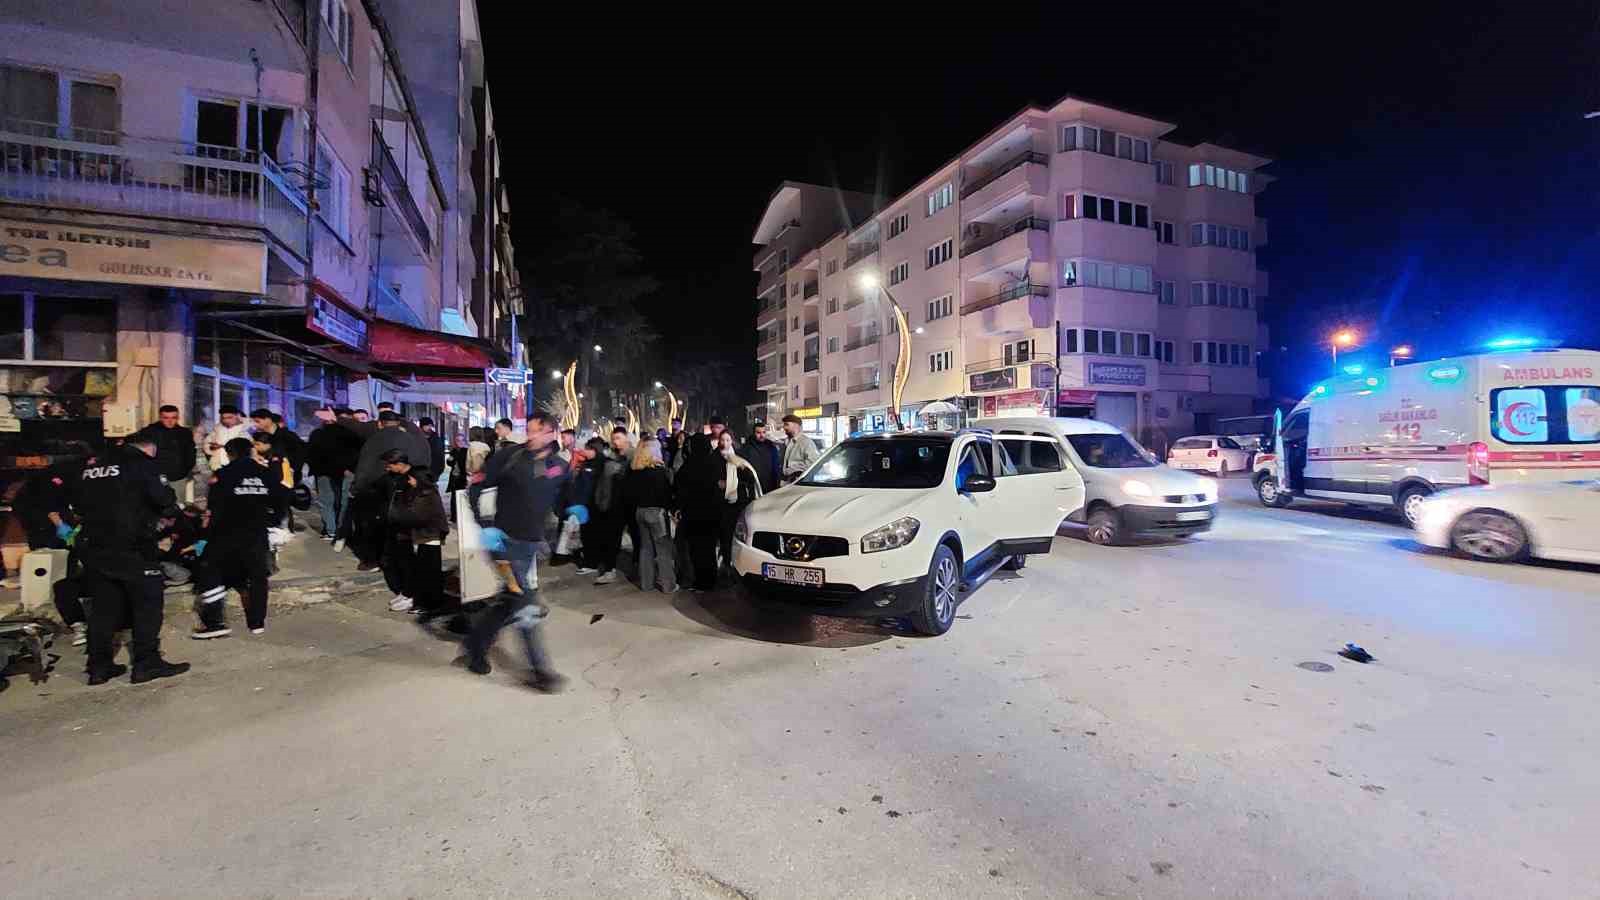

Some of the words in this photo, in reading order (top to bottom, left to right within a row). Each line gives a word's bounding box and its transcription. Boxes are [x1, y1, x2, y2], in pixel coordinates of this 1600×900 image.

[1503, 367, 1593, 380] AMBULANS
[1392, 422, 1422, 440] 112
[784, 568, 794, 578] HR
[803, 570, 820, 583] 255
